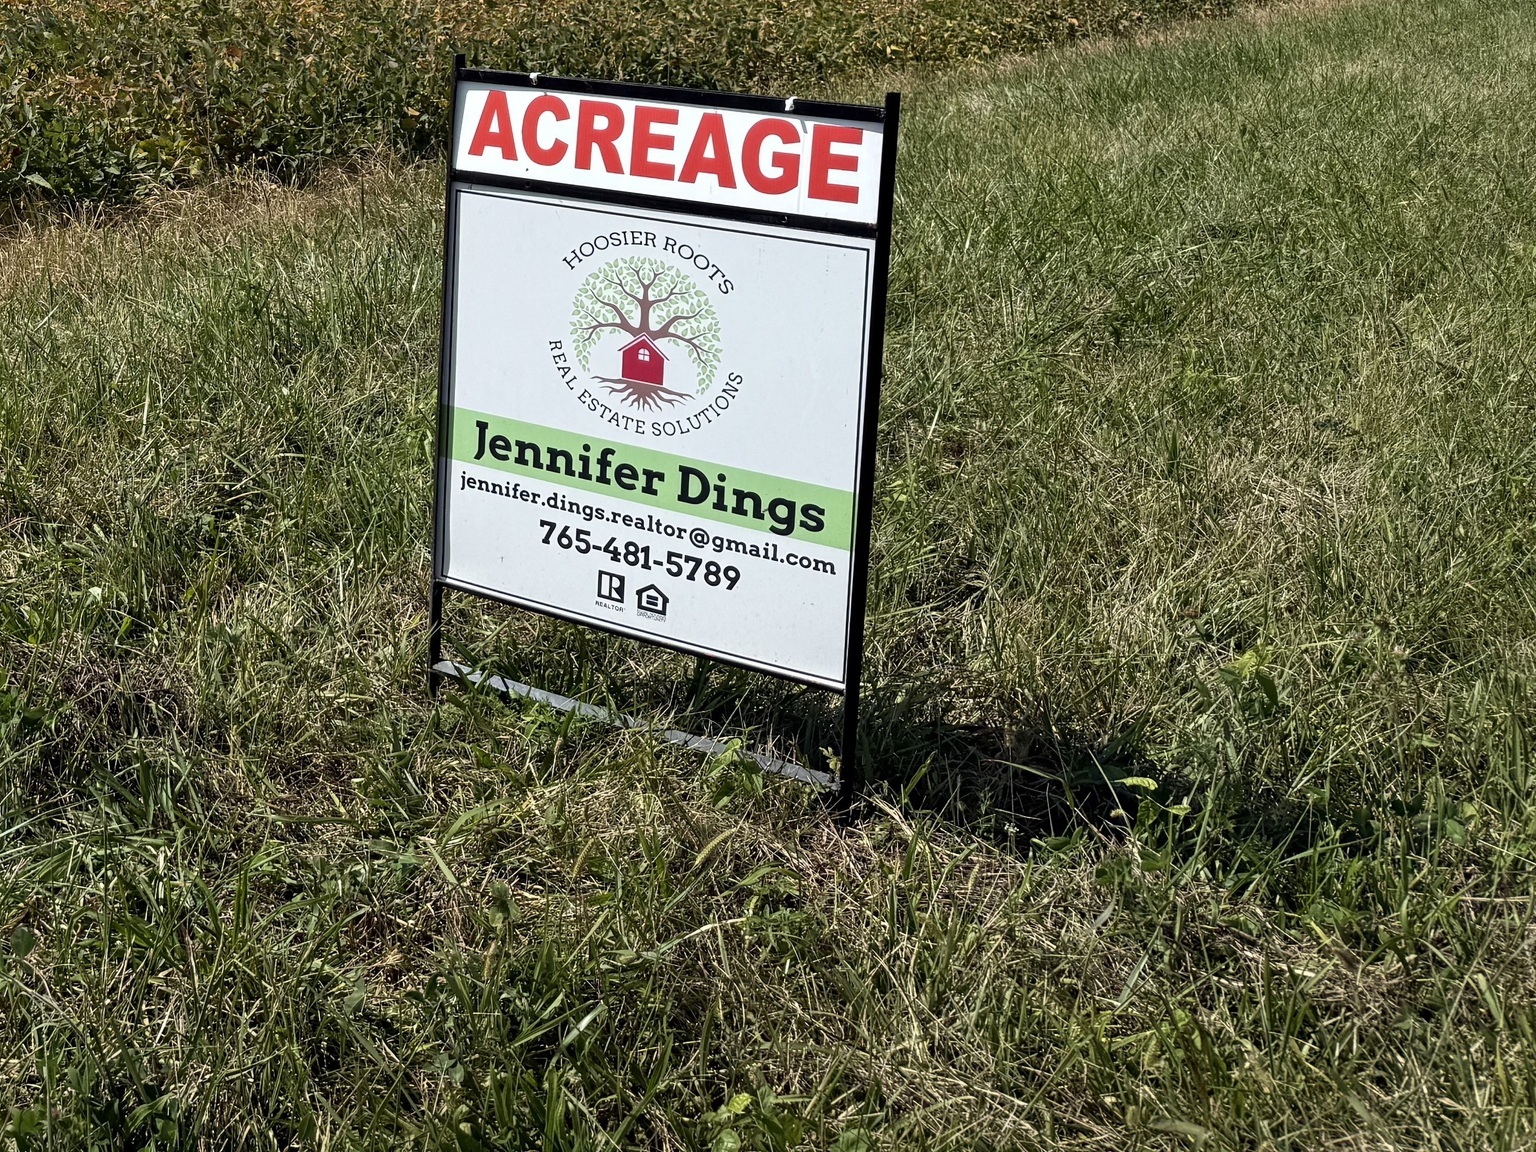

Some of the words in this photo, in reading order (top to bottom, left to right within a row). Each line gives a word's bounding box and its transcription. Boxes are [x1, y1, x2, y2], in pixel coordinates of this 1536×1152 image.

[468, 90, 863, 204] ACREAGE
[562, 230, 657, 270] HOOSIER
[662, 236, 734, 295] ROOTS
[549, 339, 578, 390] REAL
[577, 389, 646, 435] ESTATE
[651, 371, 744, 437] SOLUTIONS
[460, 471, 836, 576] jennifer.dings.realtor@gmail.com
[473, 420, 665, 497] Jennifer
[677, 465, 825, 536] Dings
[539, 519, 741, 591] 765-481-5789
